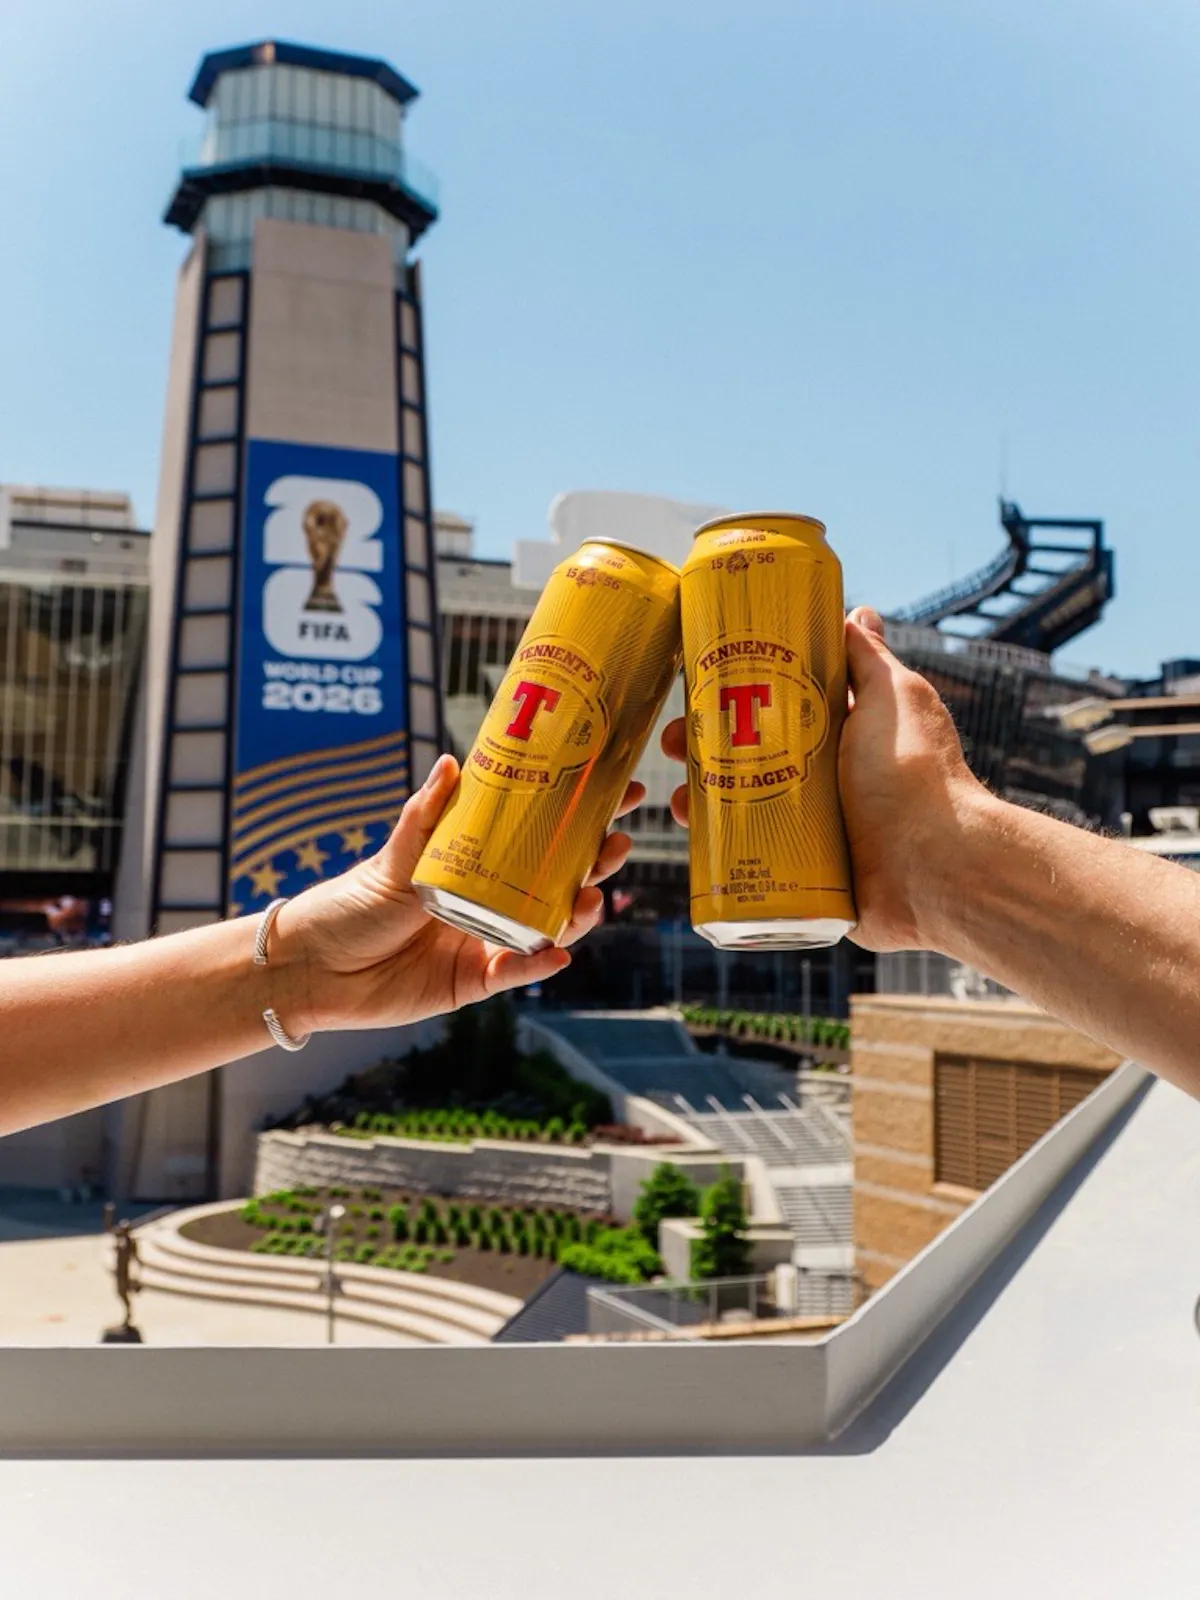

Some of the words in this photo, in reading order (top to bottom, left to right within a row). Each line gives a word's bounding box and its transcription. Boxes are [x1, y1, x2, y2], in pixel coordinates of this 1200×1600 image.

[710, 558, 724, 571] 15
[757, 552, 775, 565] 56
[566, 567, 579, 578] 15
[603, 576, 620, 590] 56
[298, 621, 351, 643] FIFA
[519, 644, 600, 683] TENNENT'S
[700, 640, 799, 672] TENNENT'S
[262, 660, 340, 683] WORLD
[341, 663, 383, 686] CUP
[262, 680, 384, 716] 2026
[505, 680, 562, 742] T
[720, 684, 772, 747] T
[472, 748, 493, 771] 1885
[493, 763, 550, 784] LAGER
[703, 771, 736, 789] 1885
[739, 765, 801, 788] LAGER
